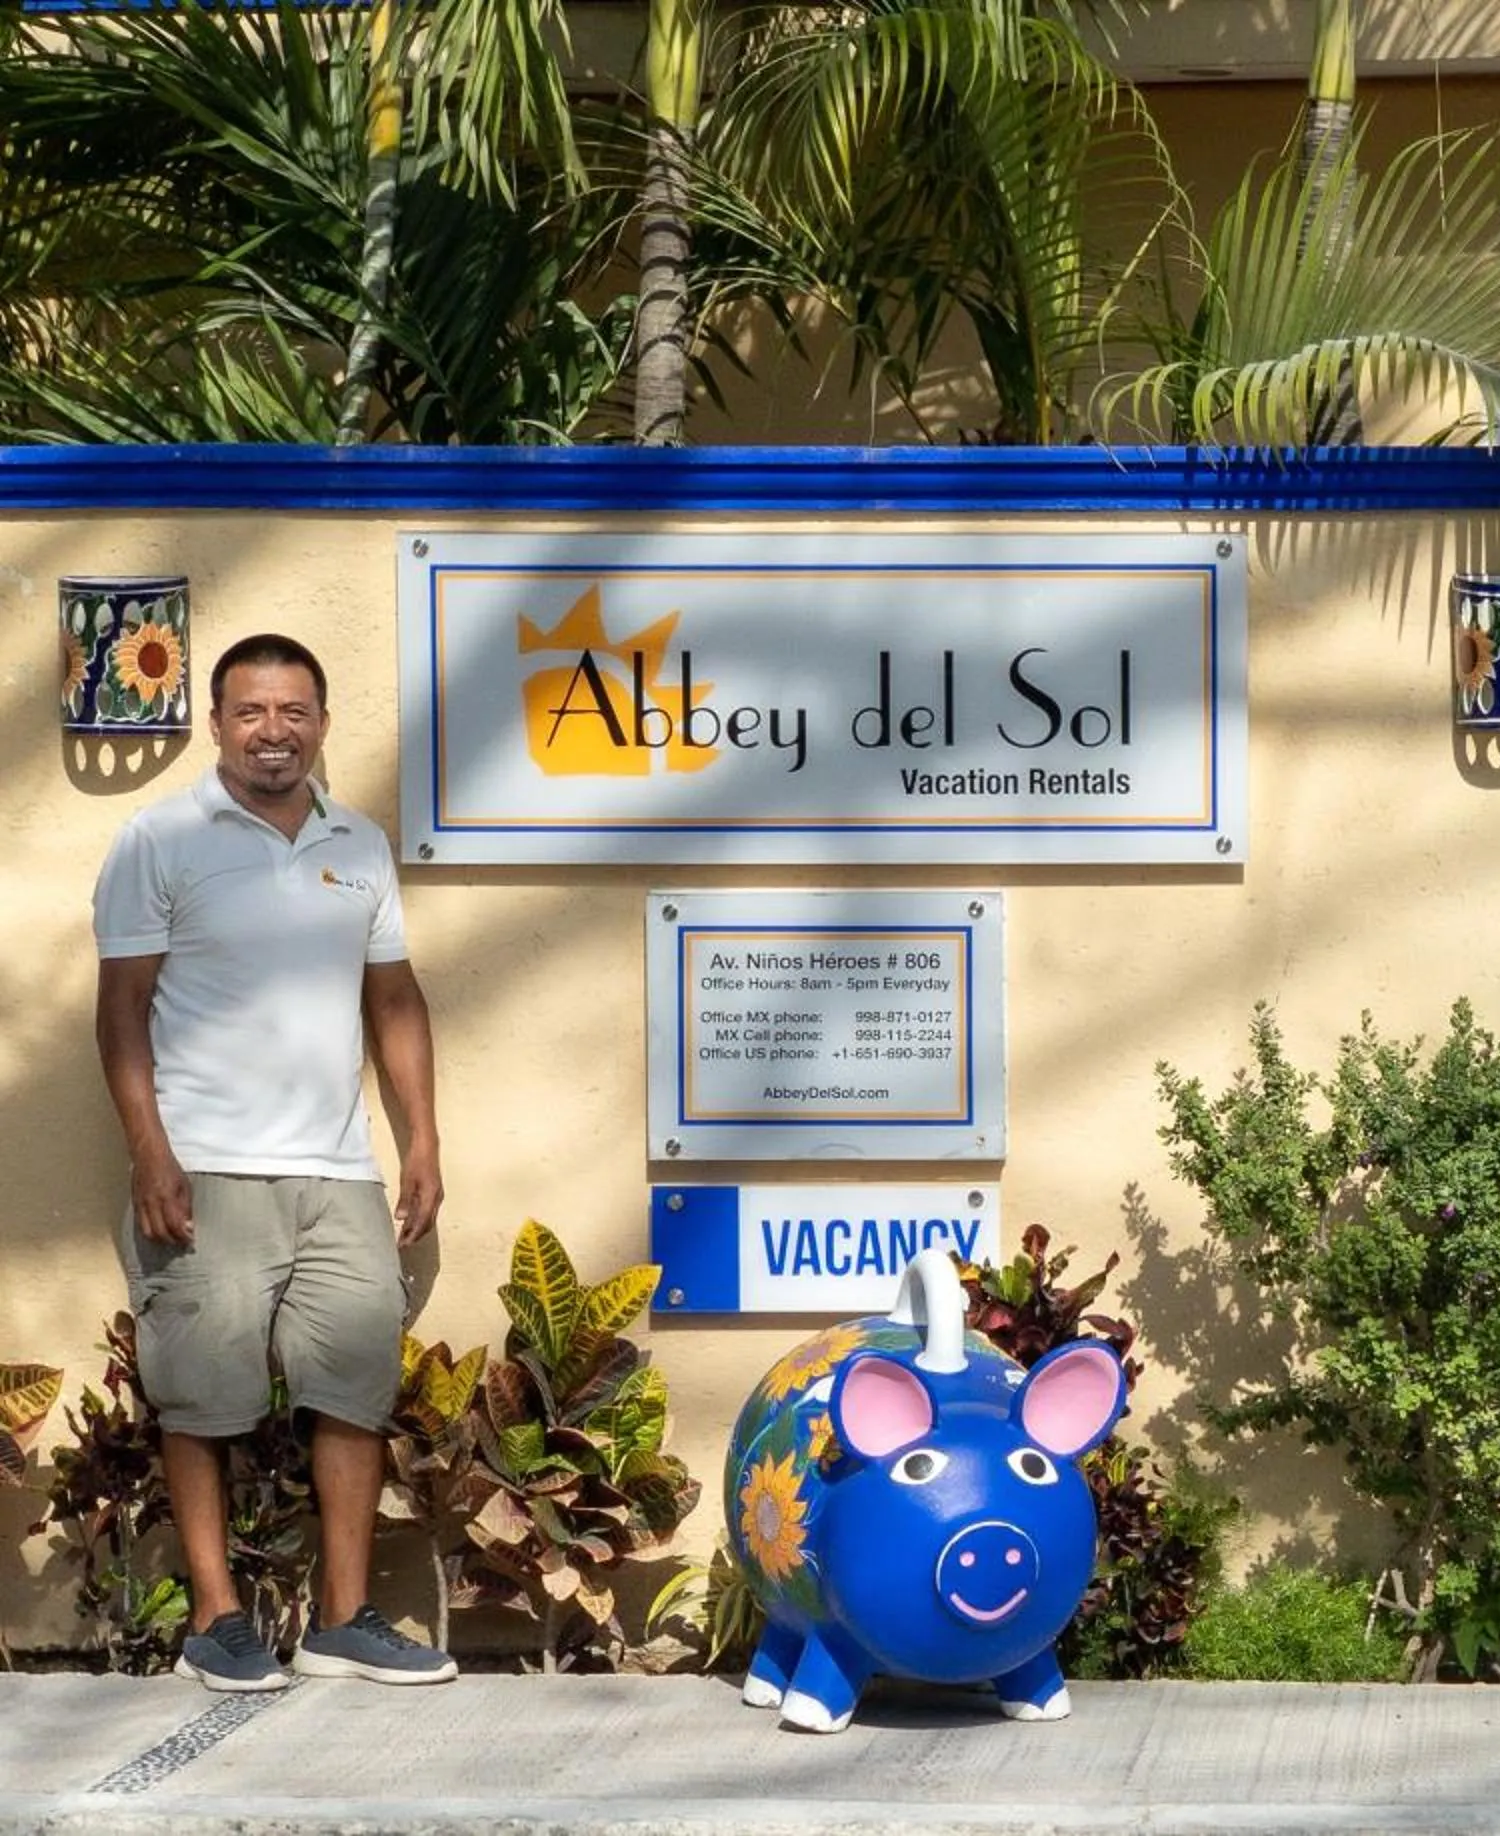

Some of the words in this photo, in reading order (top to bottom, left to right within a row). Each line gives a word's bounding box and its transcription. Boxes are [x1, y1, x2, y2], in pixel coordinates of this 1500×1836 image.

[547, 648, 807, 773] Abbey
[851, 650, 954, 750] del
[996, 648, 1131, 749] Sol
[900, 767, 1019, 795] Vacation
[1029, 767, 1131, 795] Rentals
[710, 953, 739, 970] Av.
[746, 953, 803, 970] Niños
[810, 951, 881, 970] Héroes
[887, 953, 898, 970] #
[904, 953, 942, 970] 806
[701, 976, 745, 991] Office
[750, 976, 796, 991] Hours:
[799, 977, 832, 991] 8am
[847, 977, 879, 994] 5pm
[883, 976, 950, 993] Everyday
[700, 1011, 743, 1024] Office
[746, 1011, 770, 1023] MX
[773, 1011, 824, 1027] phone:
[855, 1010, 952, 1023] 998-871-0127
[715, 1029, 739, 1041] MX
[743, 1029, 771, 1041] Cell
[773, 1029, 824, 1044] phone:
[855, 1029, 952, 1041] 998-115-2244
[699, 1047, 741, 1060] Office
[745, 1047, 767, 1060] US
[769, 1047, 820, 1063] phone:
[763, 1085, 890, 1102] AbbeyDelSol.com
